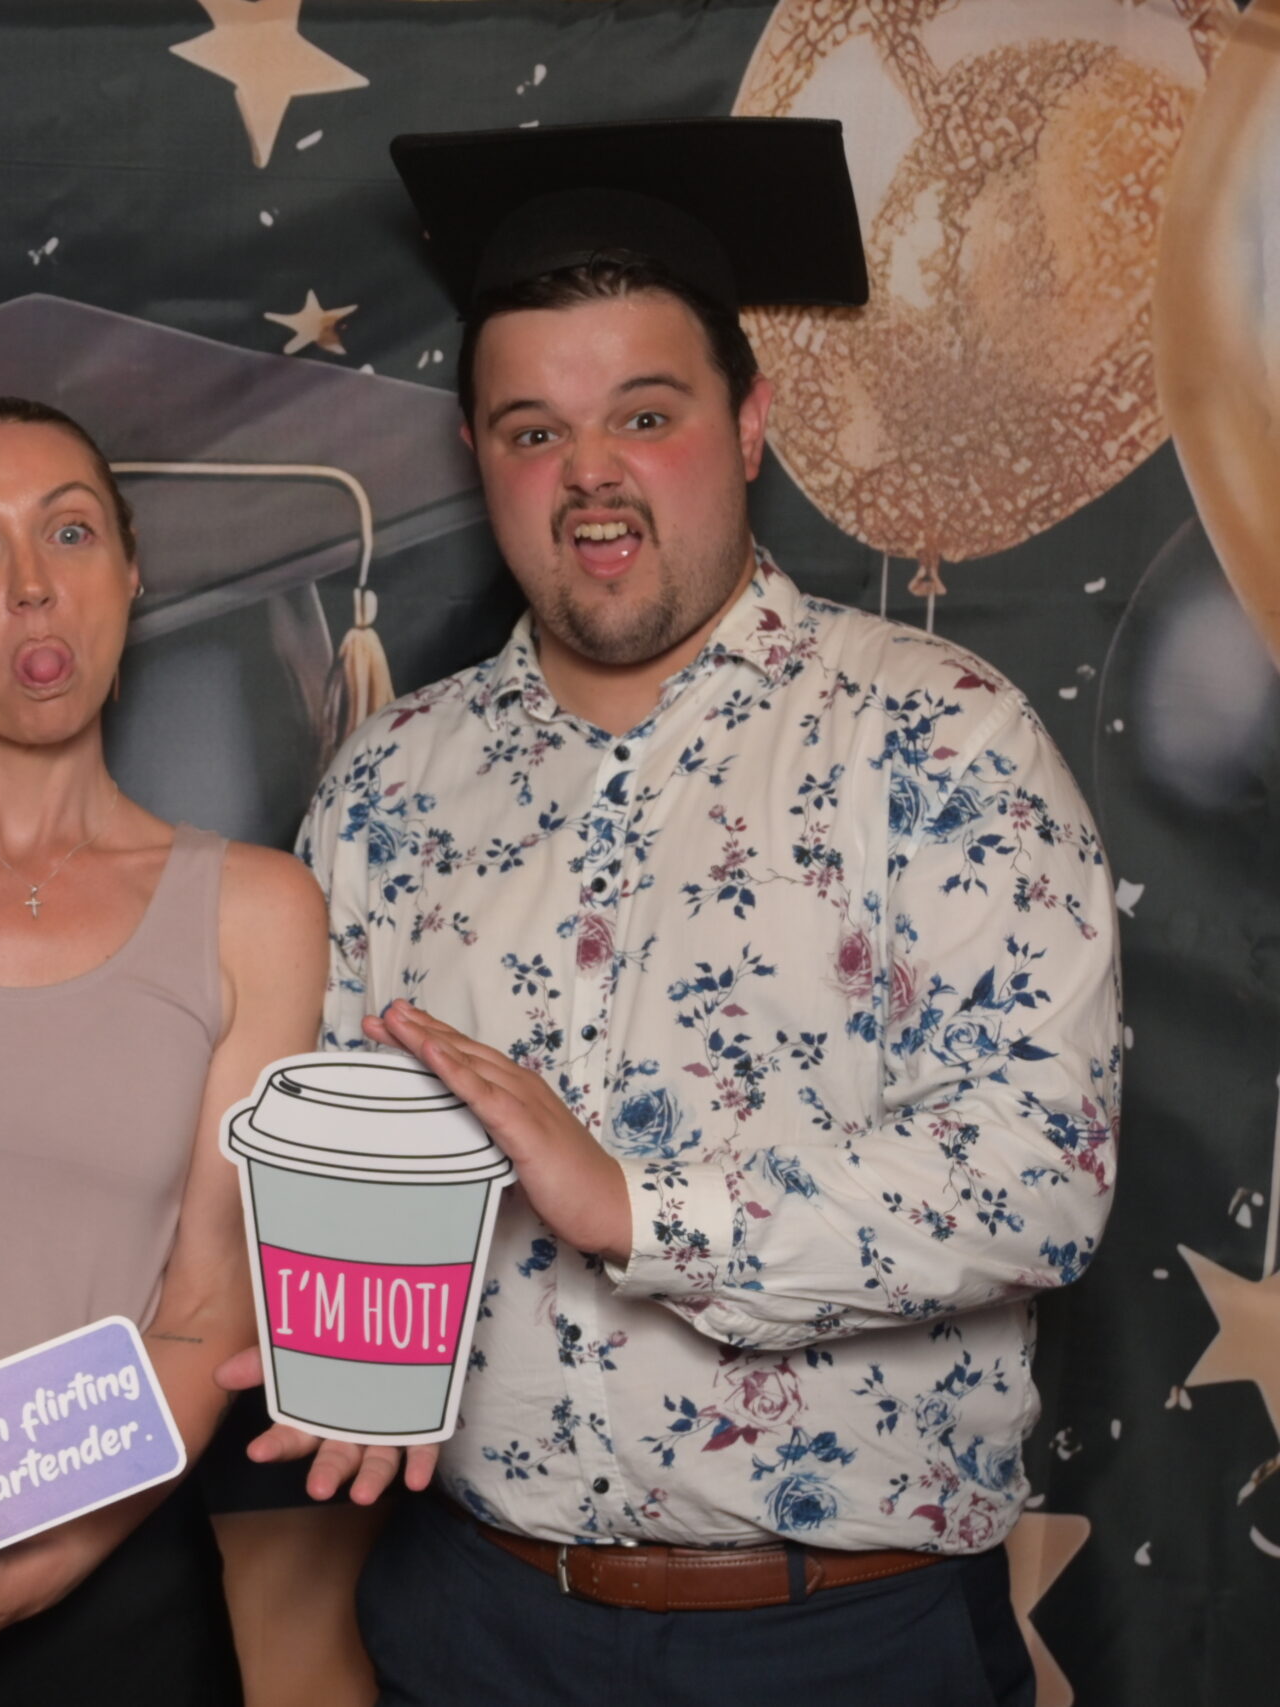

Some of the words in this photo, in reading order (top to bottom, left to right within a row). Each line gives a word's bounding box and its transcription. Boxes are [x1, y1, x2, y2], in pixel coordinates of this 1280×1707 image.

[276, 1269, 345, 1342] I'M
[364, 1277, 449, 1353] HOT!
[22, 1364, 140, 1430] flirting
